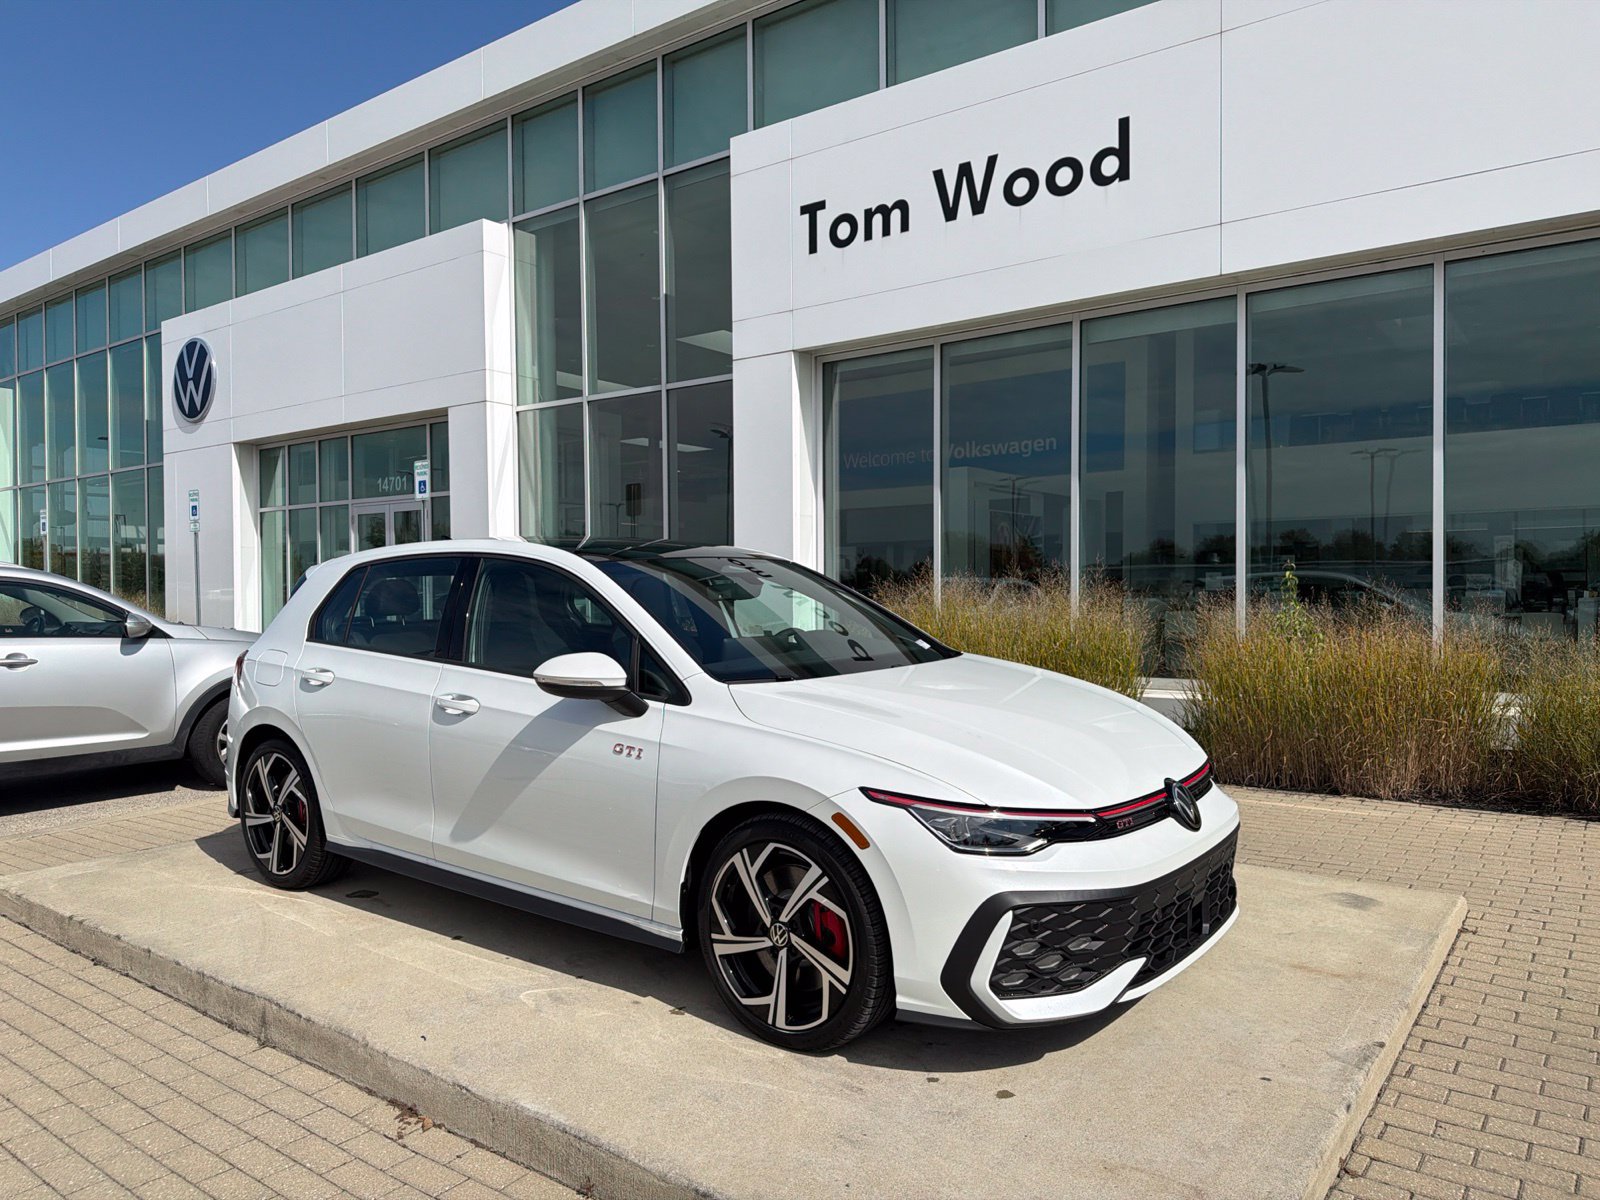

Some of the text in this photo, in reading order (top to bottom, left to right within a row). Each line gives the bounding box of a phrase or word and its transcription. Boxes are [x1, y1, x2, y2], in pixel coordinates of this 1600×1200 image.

[800, 115, 1130, 255] Tom Wood
[174, 337, 216, 423] VW
[843, 450, 916, 469] Welcome
[377, 475, 407, 492] 14701
[612, 743, 643, 760] GTI
[1116, 818, 1134, 829] GTI
